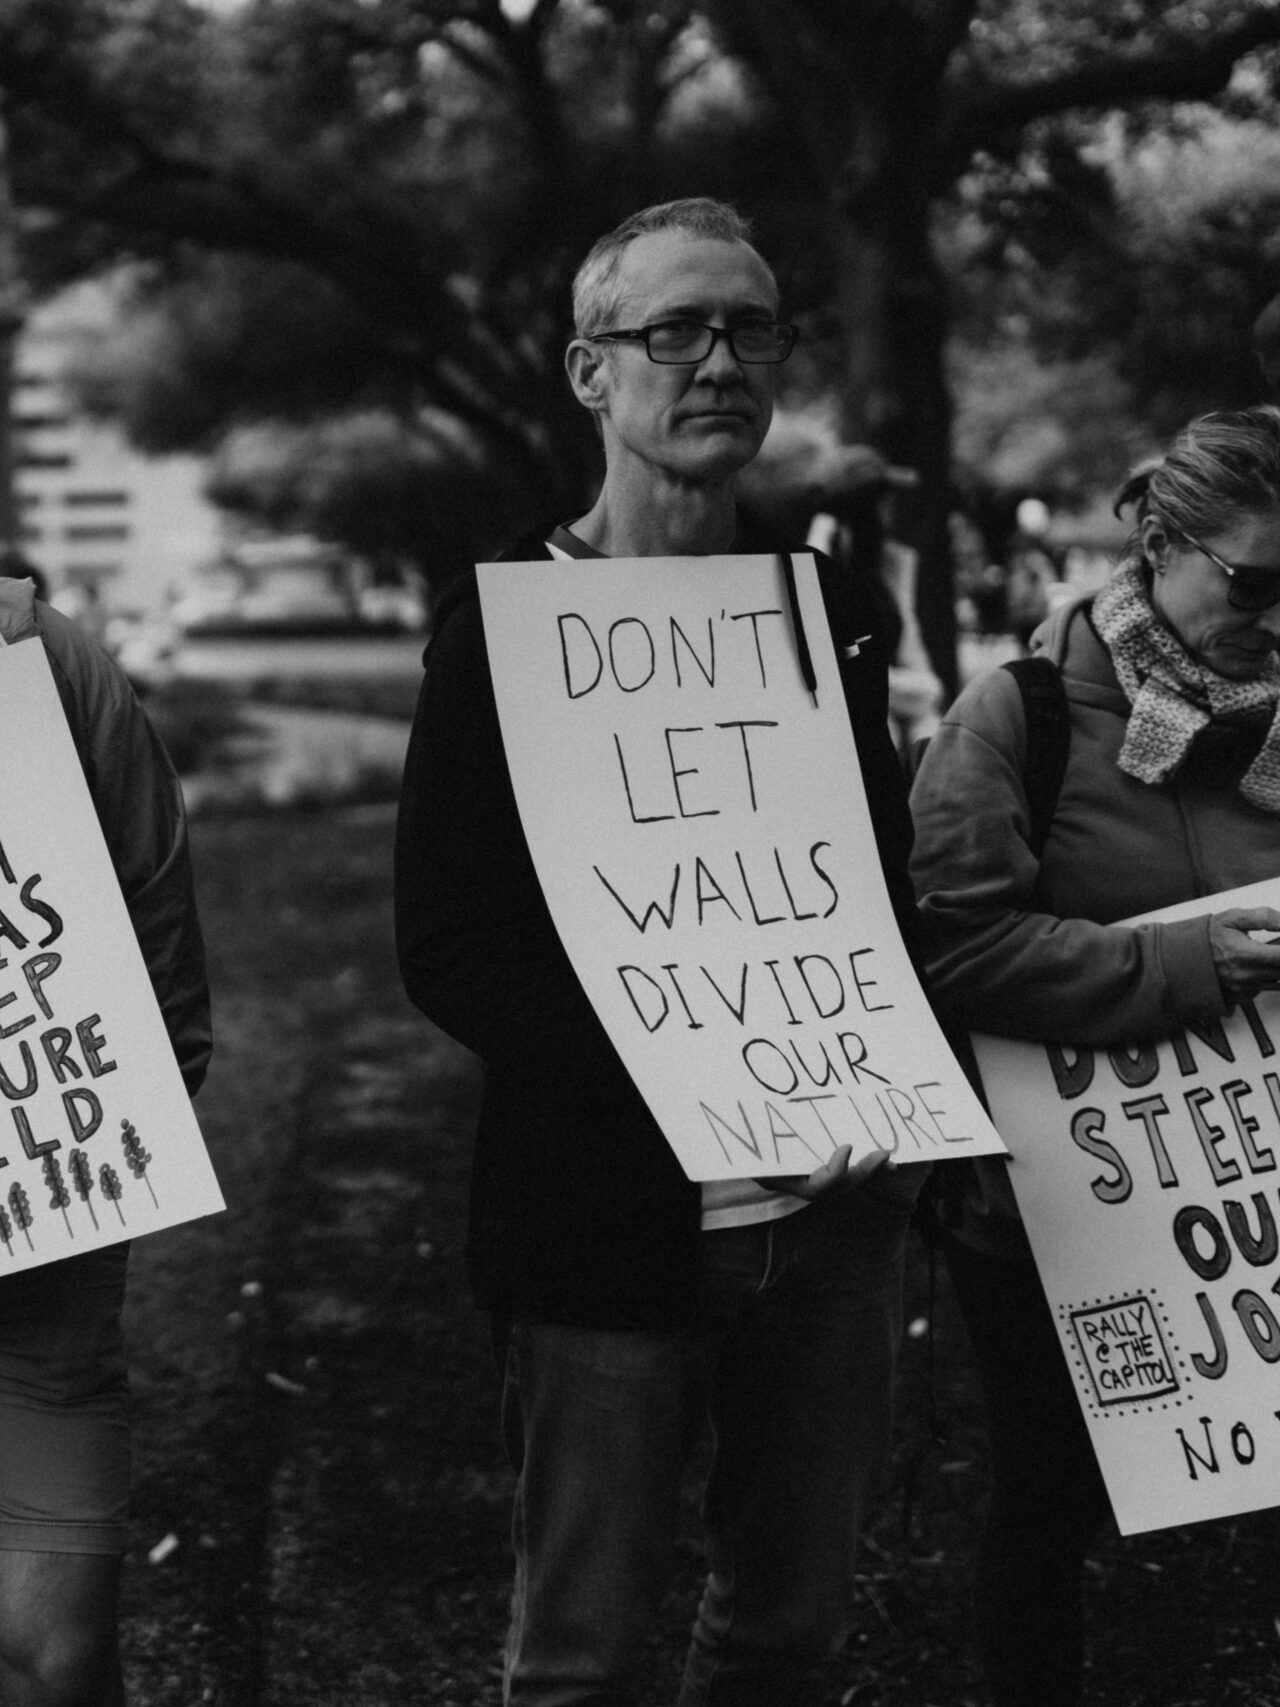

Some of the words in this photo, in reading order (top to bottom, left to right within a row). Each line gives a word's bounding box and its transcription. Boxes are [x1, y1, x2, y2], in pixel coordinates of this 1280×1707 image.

[557, 609, 783, 699] DON'T
[614, 720, 780, 823] LET
[593, 842, 839, 934] WALLS
[617, 948, 896, 1033] DIVIDE
[742, 1031, 892, 1095] OUR
[699, 1082, 975, 1172] NATURE
[1173, 1187, 1280, 1282] OU
[1083, 1305, 1147, 1343] RALLY
[1115, 1334, 1154, 1366] THE
[1190, 1278, 1280, 1380] JO
[1100, 1358, 1175, 1389] CAPITOL
